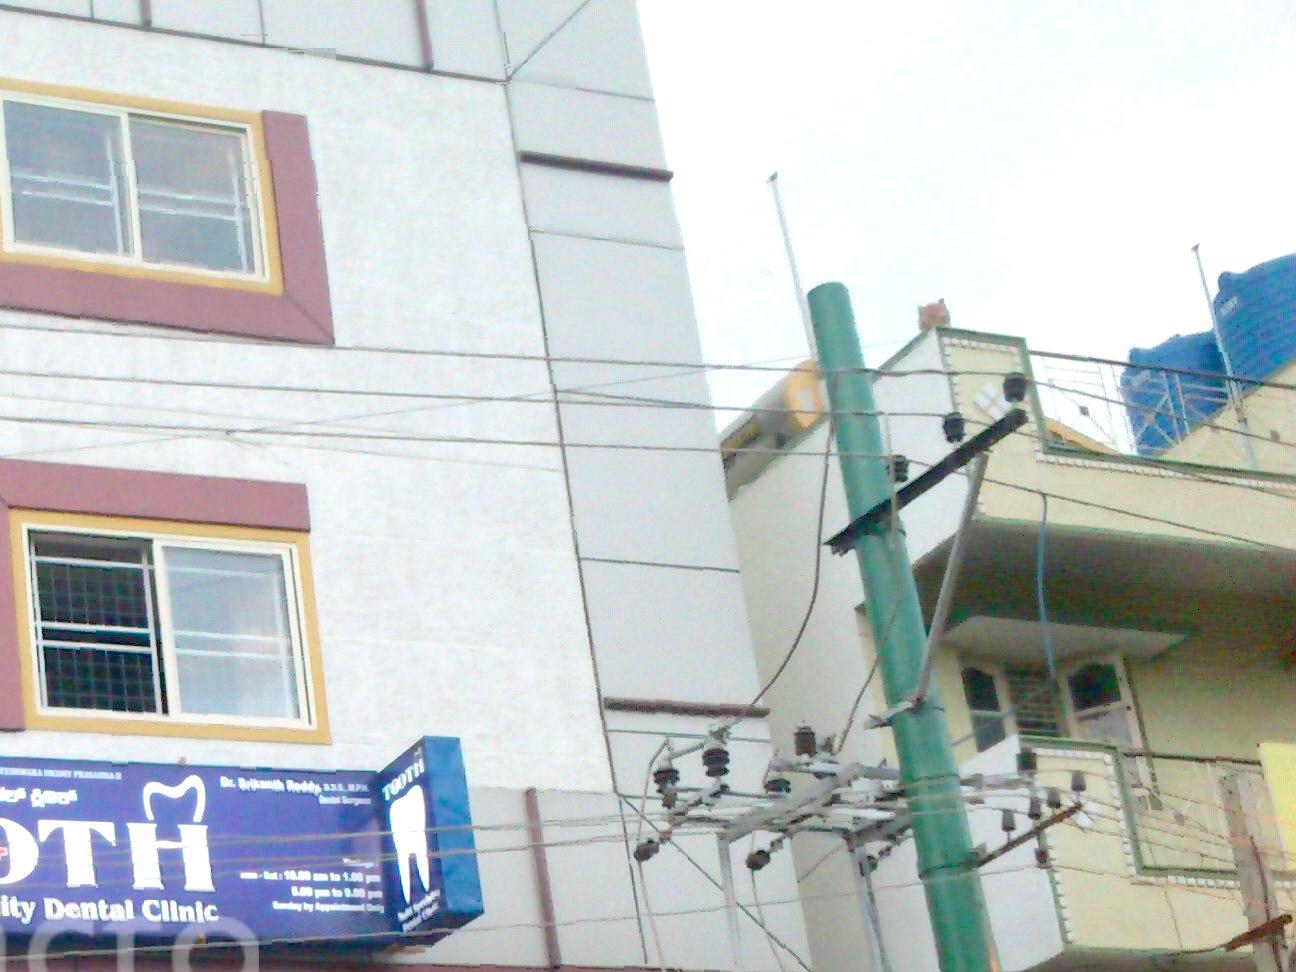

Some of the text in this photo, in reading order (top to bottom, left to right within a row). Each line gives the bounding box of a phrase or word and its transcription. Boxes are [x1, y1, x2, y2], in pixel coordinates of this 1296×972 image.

[382, 758, 425, 800] TOOTH
[43, 895, 134, 922] Dental
[141, 899, 219, 923] Clinic
